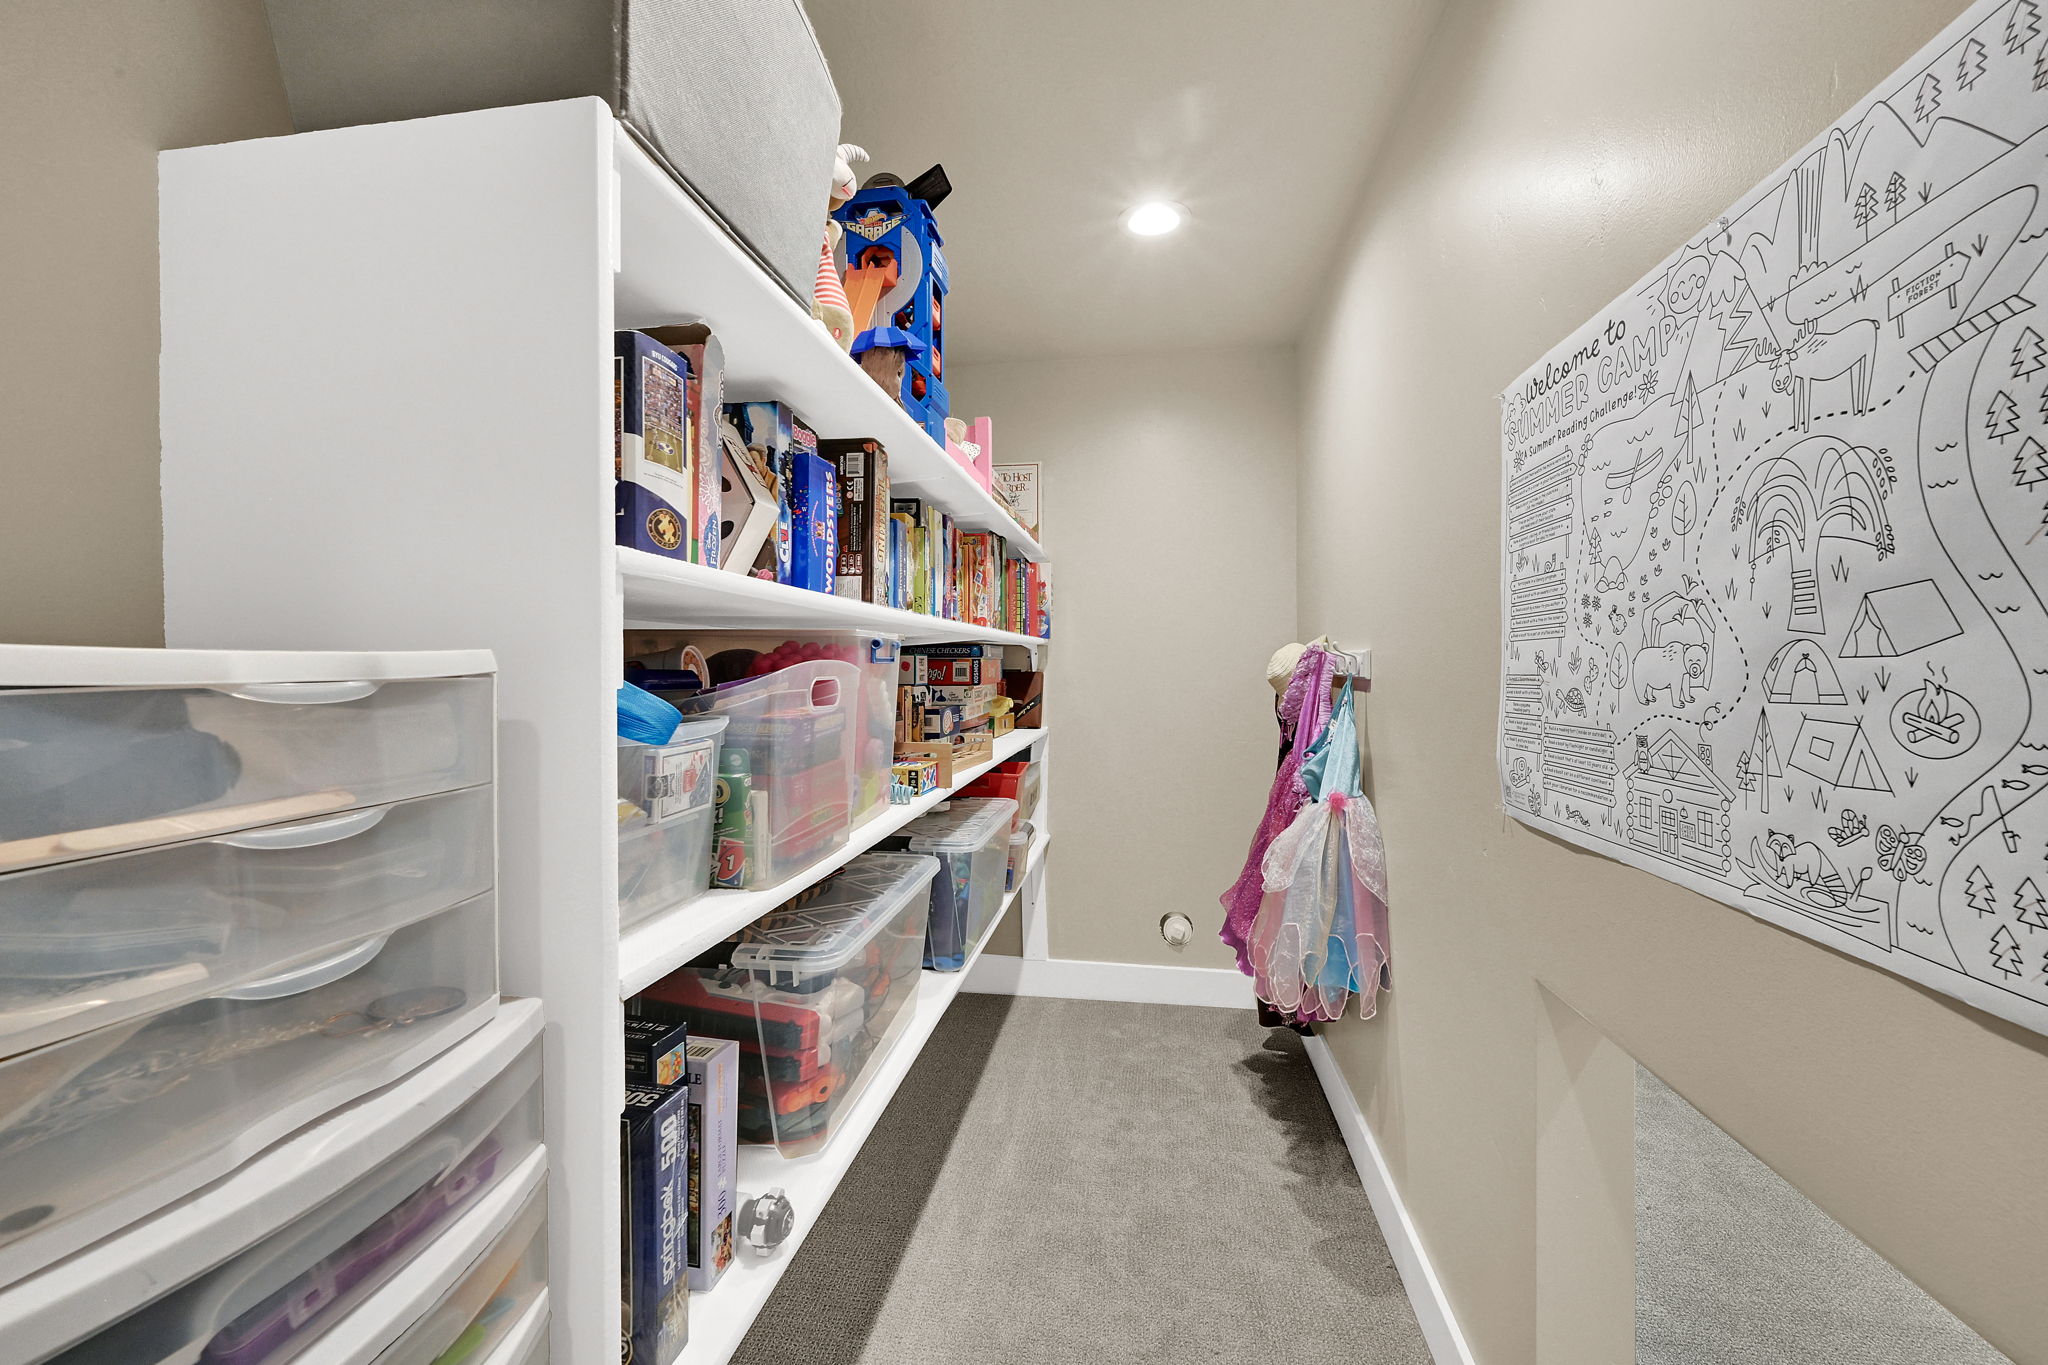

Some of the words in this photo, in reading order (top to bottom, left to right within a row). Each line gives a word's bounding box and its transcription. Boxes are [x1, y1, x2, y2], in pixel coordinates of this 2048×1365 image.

[846, 216, 903, 242] GARAGE
[1906, 270, 1942, 297] FICTION
[1907, 280, 1940, 304] FOREST
[1525, 338, 1600, 403] Welcome
[1604, 319, 1626, 346] to
[1504, 373, 1589, 451] SUMMER
[1598, 315, 1677, 393] CAMP
[793, 424, 817, 447] Boggle
[1523, 450, 1529, 461] A
[1529, 435, 1556, 457] Summer
[1557, 417, 1588, 442] Reading
[1589, 385, 1637, 423] Challenge!
[1012, 472, 1033, 482] HOST
[824, 471, 835, 594] WORDSTERS
[877, 478, 886, 563] TREKKING
[780, 521, 790, 563] CLUE
[909, 647, 937, 655] CHINESE
[937, 646, 971, 655] CHECKERS
[661, 1114, 677, 1172] 500
[717, 1190, 727, 1219] 300
